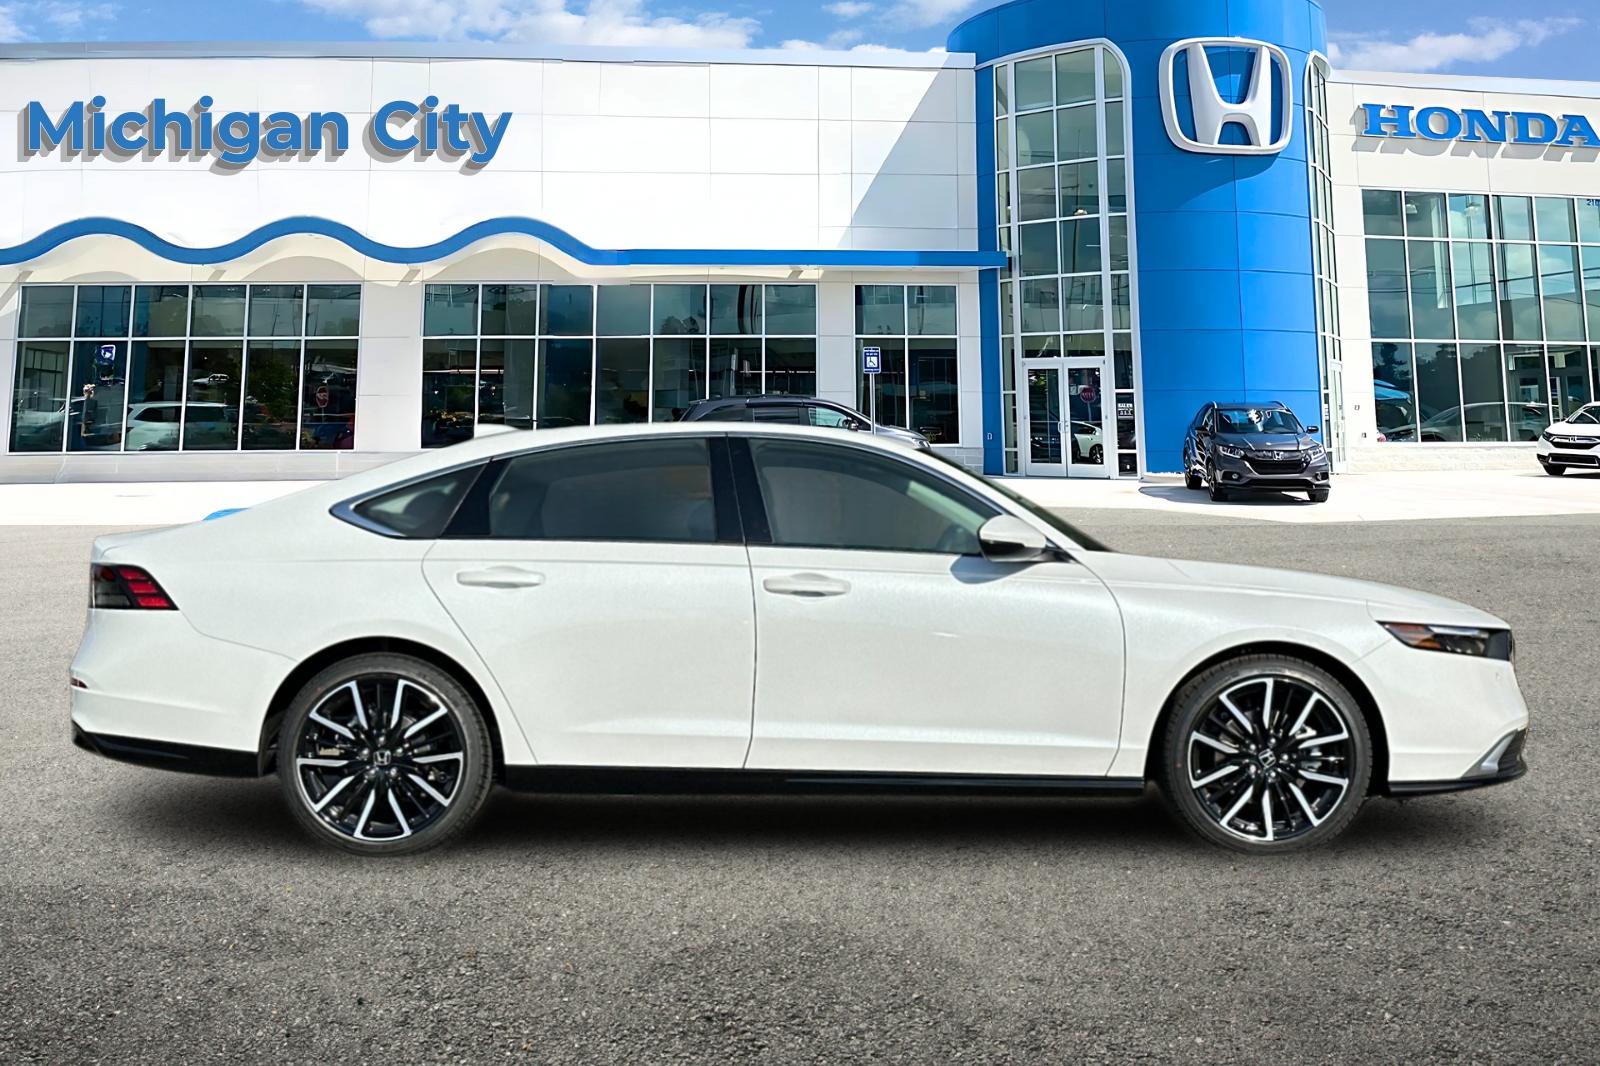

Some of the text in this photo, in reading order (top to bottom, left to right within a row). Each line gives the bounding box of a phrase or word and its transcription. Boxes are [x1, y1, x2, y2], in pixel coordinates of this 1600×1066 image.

[27, 95, 514, 164] Michigan City
[1361, 103, 1600, 147] HONDA
